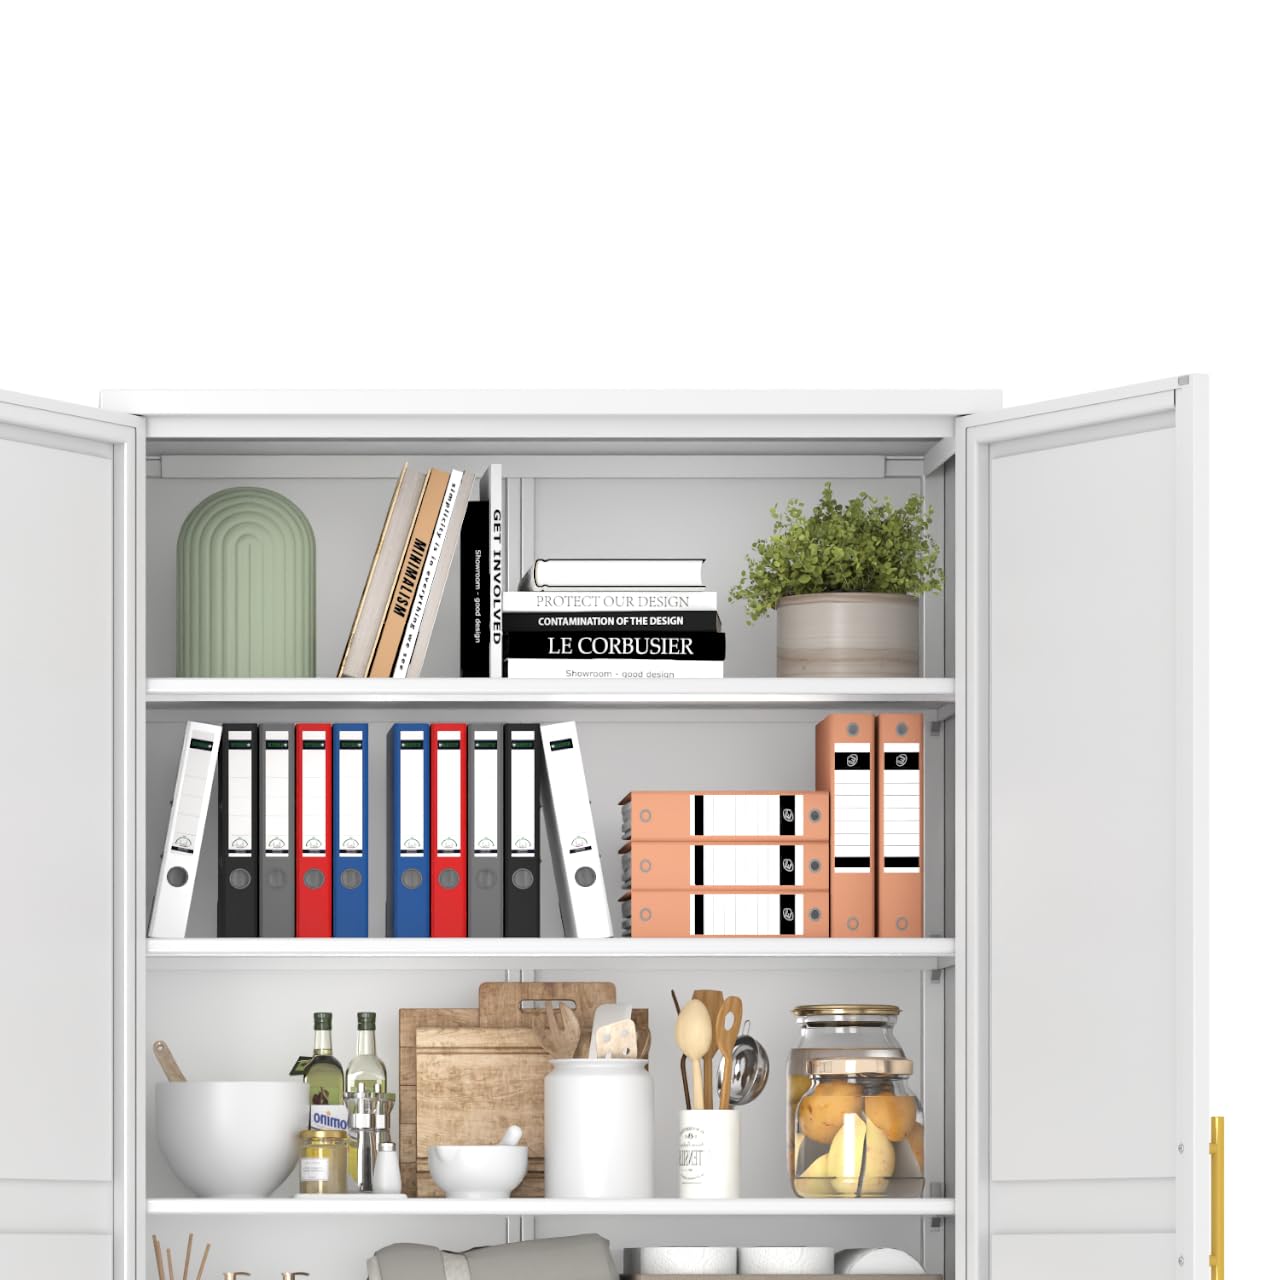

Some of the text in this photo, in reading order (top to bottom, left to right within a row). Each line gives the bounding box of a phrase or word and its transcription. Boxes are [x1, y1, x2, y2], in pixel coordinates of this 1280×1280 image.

[437, 483, 456, 538] simplicity
[429, 554, 437, 566] in
[393, 538, 426, 618] MINIMALISM
[492, 509, 502, 645] GET INVOLVED
[410, 570, 432, 630] everything
[536, 596, 690, 608] PROTECT OUR DESIGN
[474, 618, 482, 644] design
[538, 616, 684, 626] CONTAMINATION OF THE DESIGN
[406, 634, 412, 648] we
[548, 636, 694, 656] LE CORBUSIER
[566, 670, 612, 678] Showroom
[621, 670, 644, 678] good
[646, 670, 674, 678] design
